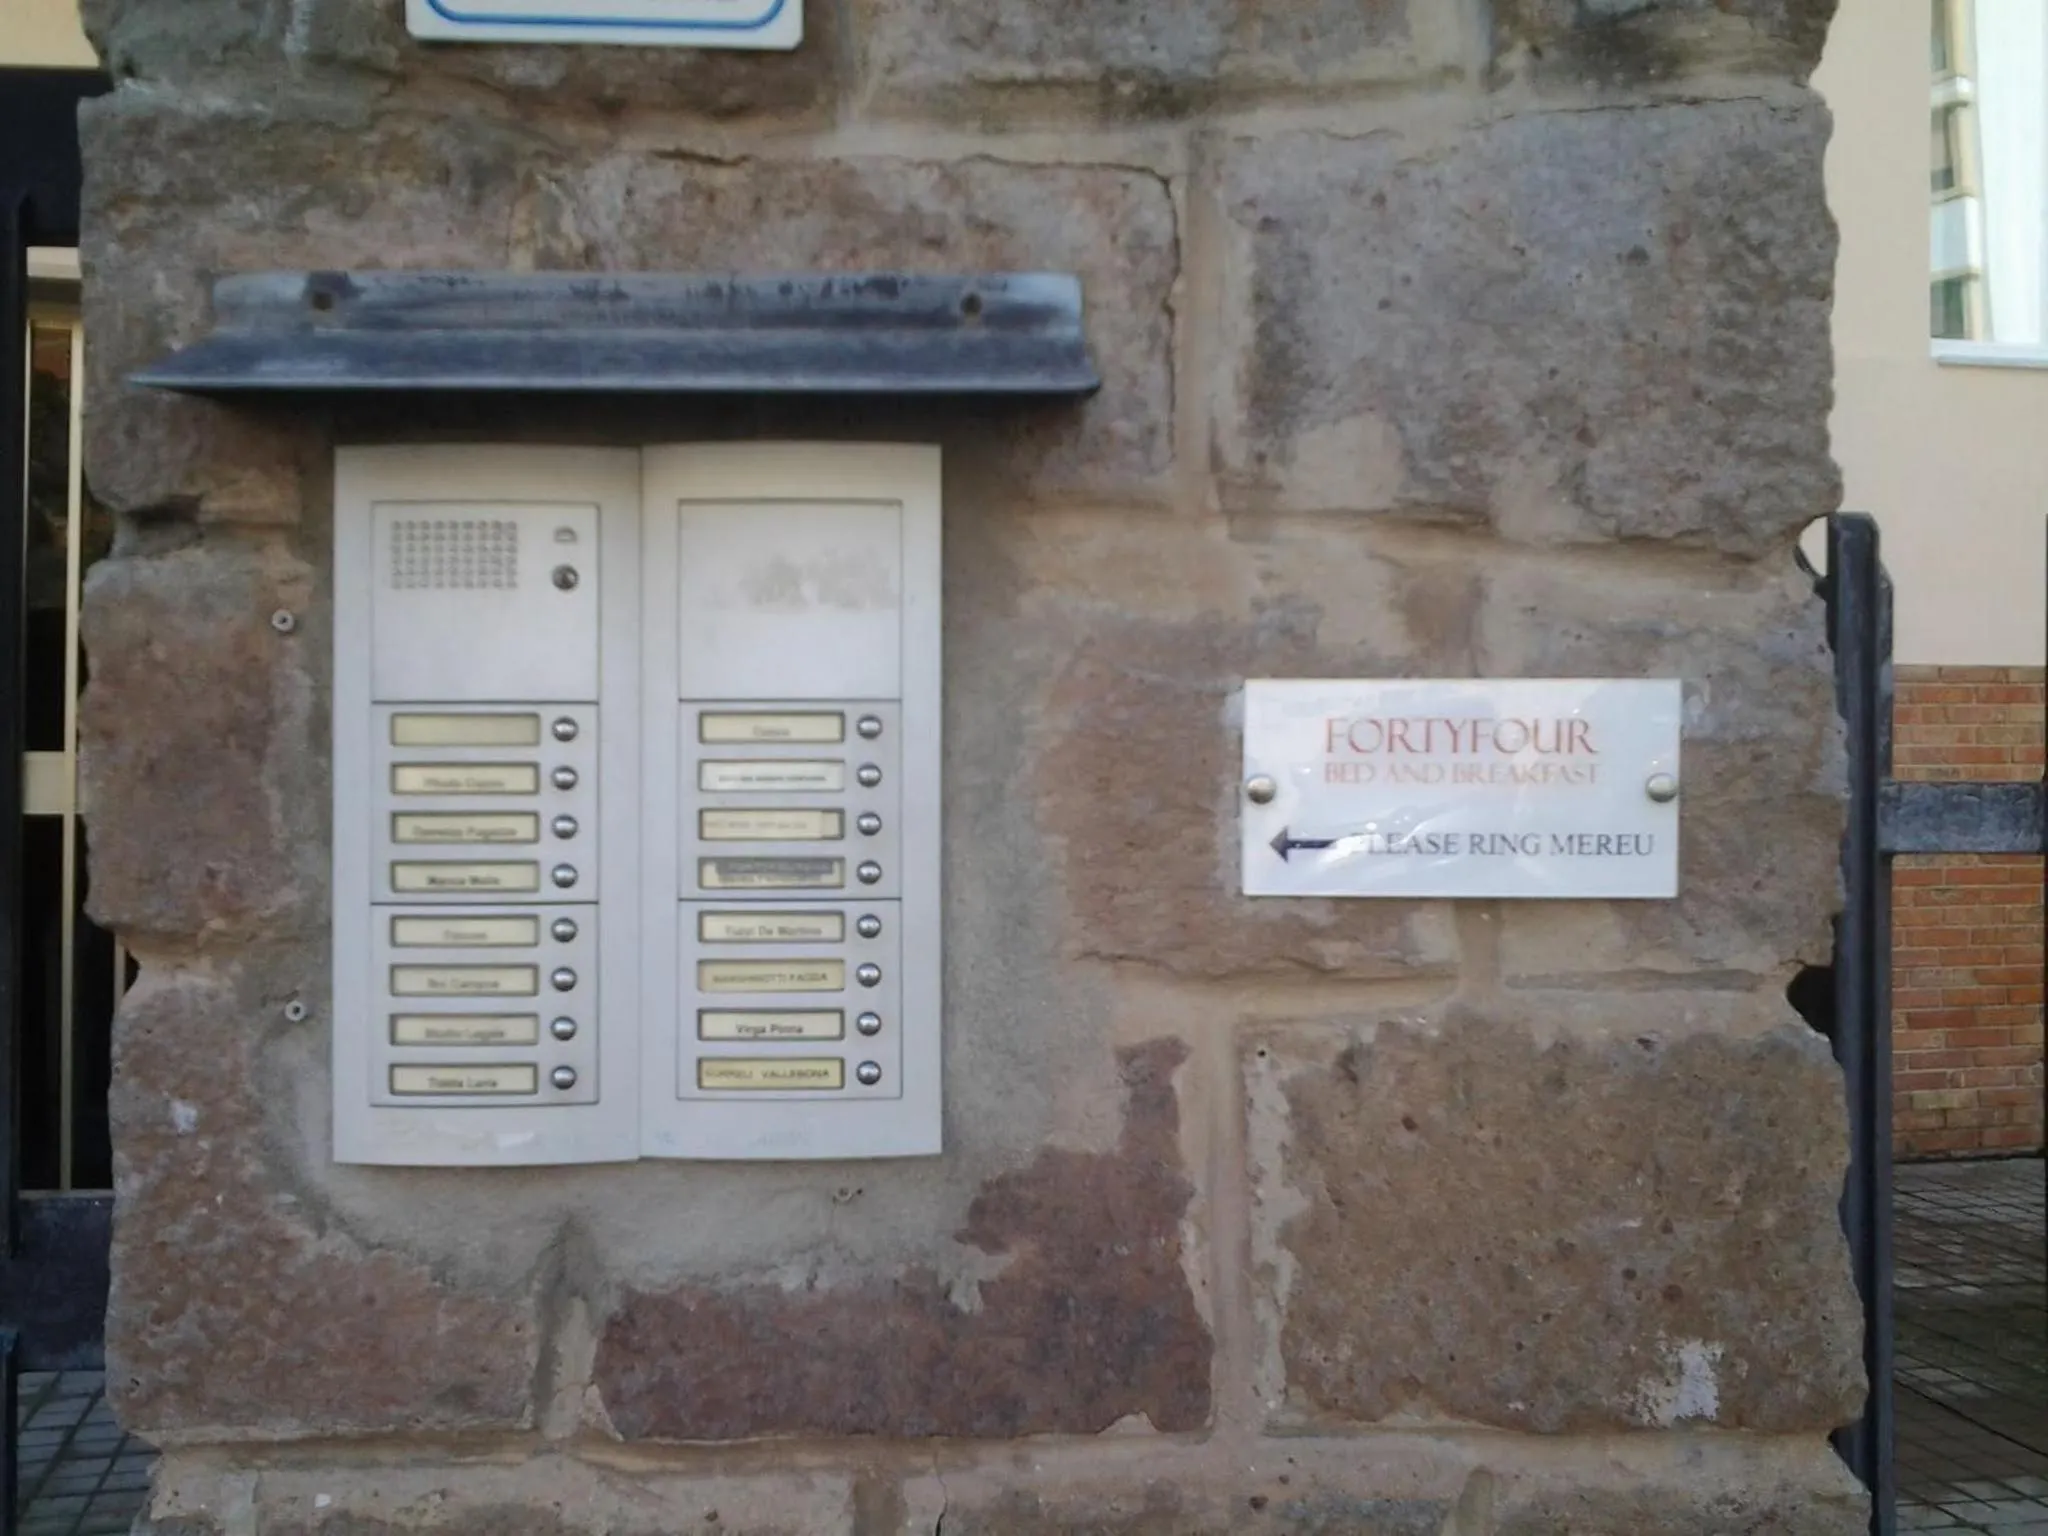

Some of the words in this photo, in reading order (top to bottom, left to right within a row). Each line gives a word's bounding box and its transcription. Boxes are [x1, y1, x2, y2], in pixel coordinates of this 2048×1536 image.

[1324, 717, 1599, 754] FORTYFOUR
[1324, 761, 1377, 785] BED
[1385, 761, 1446, 785] AND
[1452, 761, 1599, 785] BREAKFAST
[1352, 832, 1459, 856] LEASE
[1468, 832, 1541, 856] RING
[1550, 832, 1655, 857] MEREU
